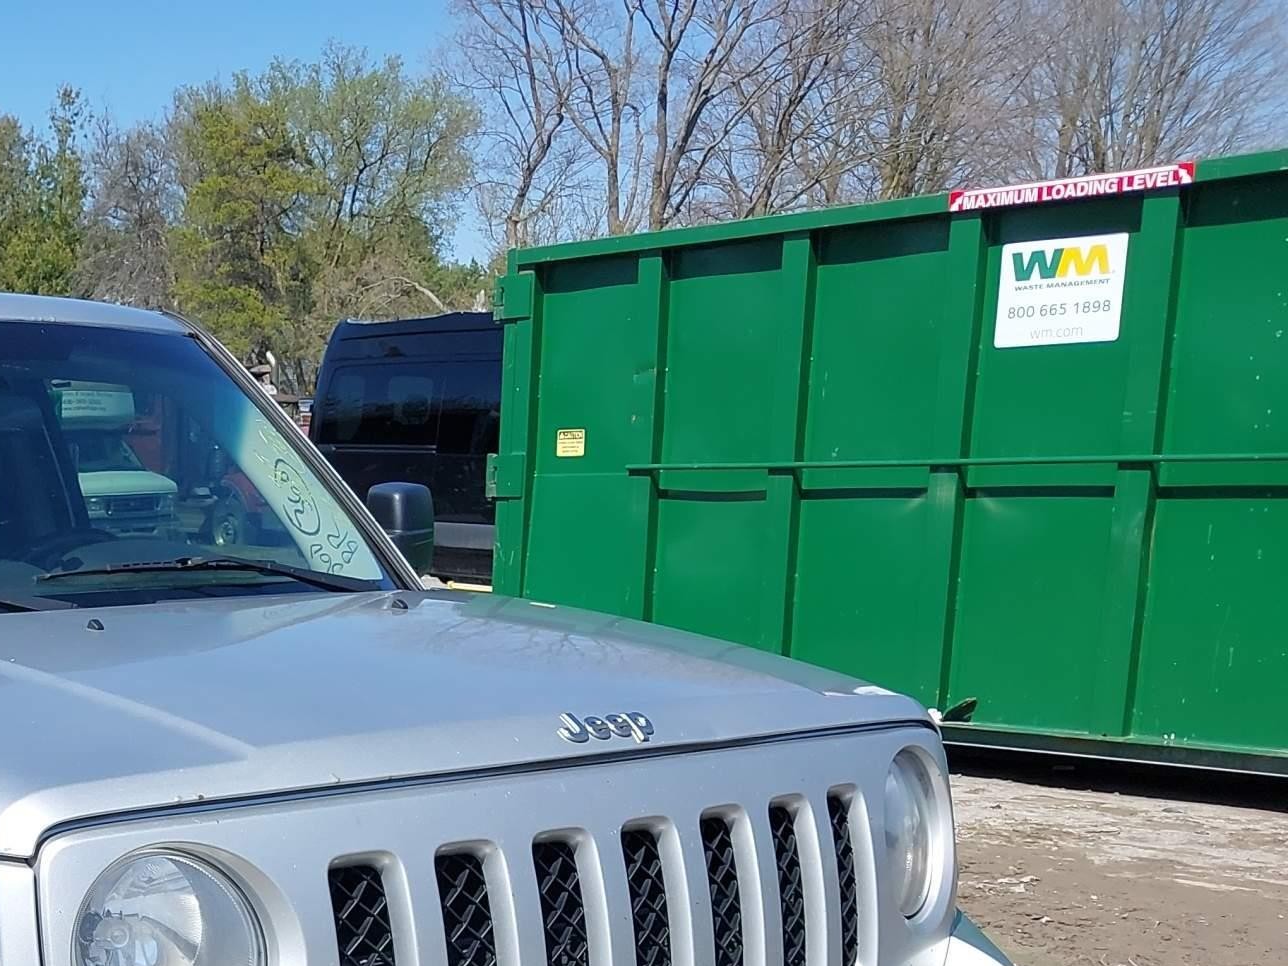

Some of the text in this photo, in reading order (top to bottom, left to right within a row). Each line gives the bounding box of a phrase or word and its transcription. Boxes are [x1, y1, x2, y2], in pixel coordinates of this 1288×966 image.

[963, 171, 1178, 209] MAXIMUM LOADING LEVEL
[1012, 243, 1111, 282] WM
[1015, 278, 1112, 291] WASTE MANAGEMENT
[1008, 299, 1112, 319] 800 665 1898
[1030, 326, 1084, 339] wm.com
[556, 711, 655, 744] Jeep
